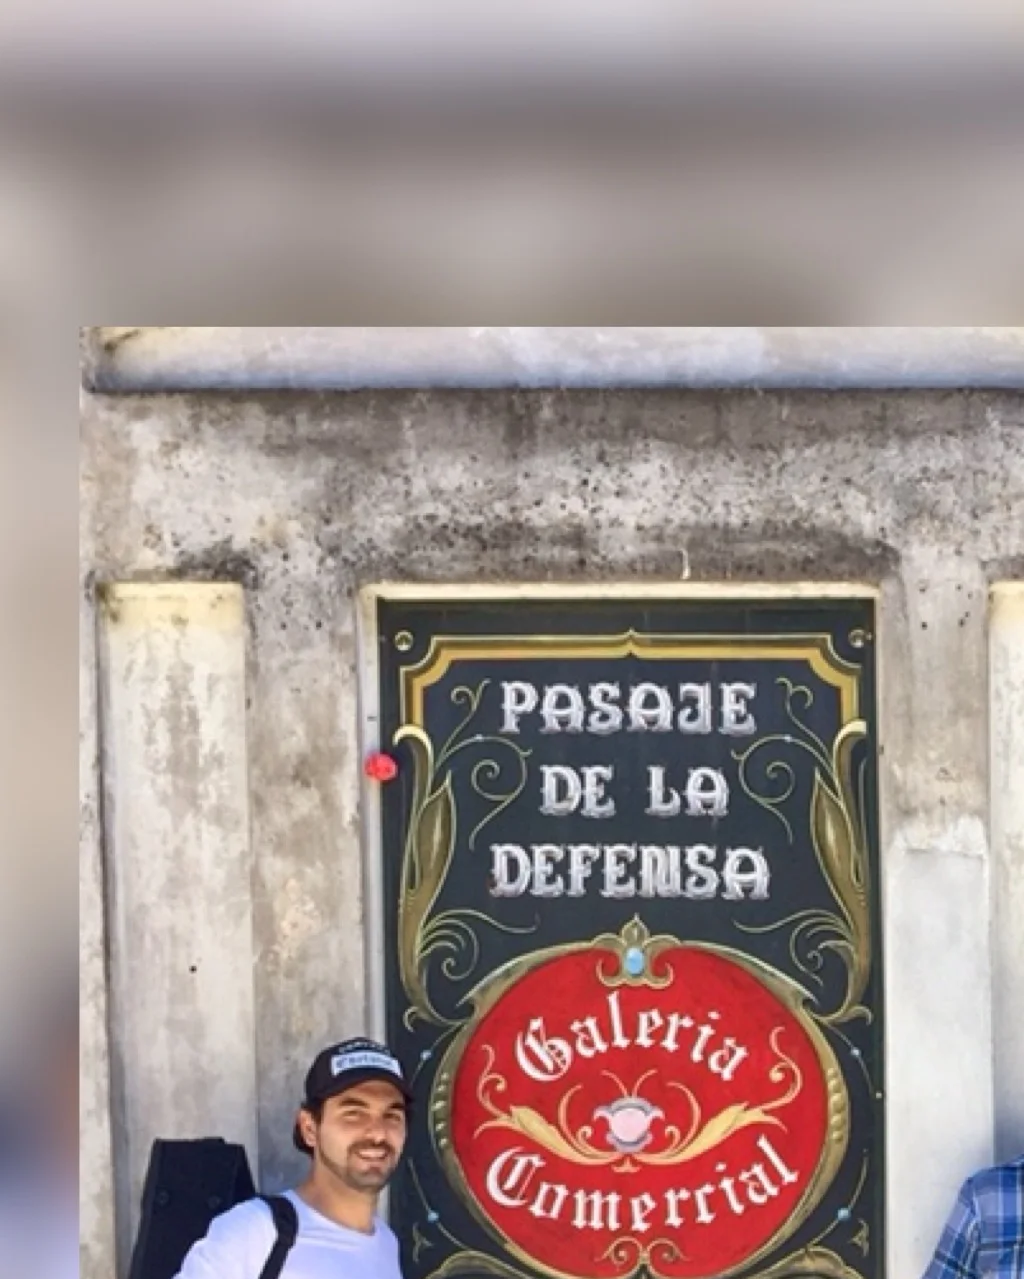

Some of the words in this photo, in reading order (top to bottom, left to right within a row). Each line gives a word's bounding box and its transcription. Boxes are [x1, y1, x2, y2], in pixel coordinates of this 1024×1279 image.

[499, 681, 757, 735] PASAJE
[538, 764, 616, 818] DE
[645, 765, 730, 817] LA
[489, 843, 771, 899] DEFENSA
[515, 991, 749, 1082] Galeria
[485, 1135, 799, 1231] Comercial
